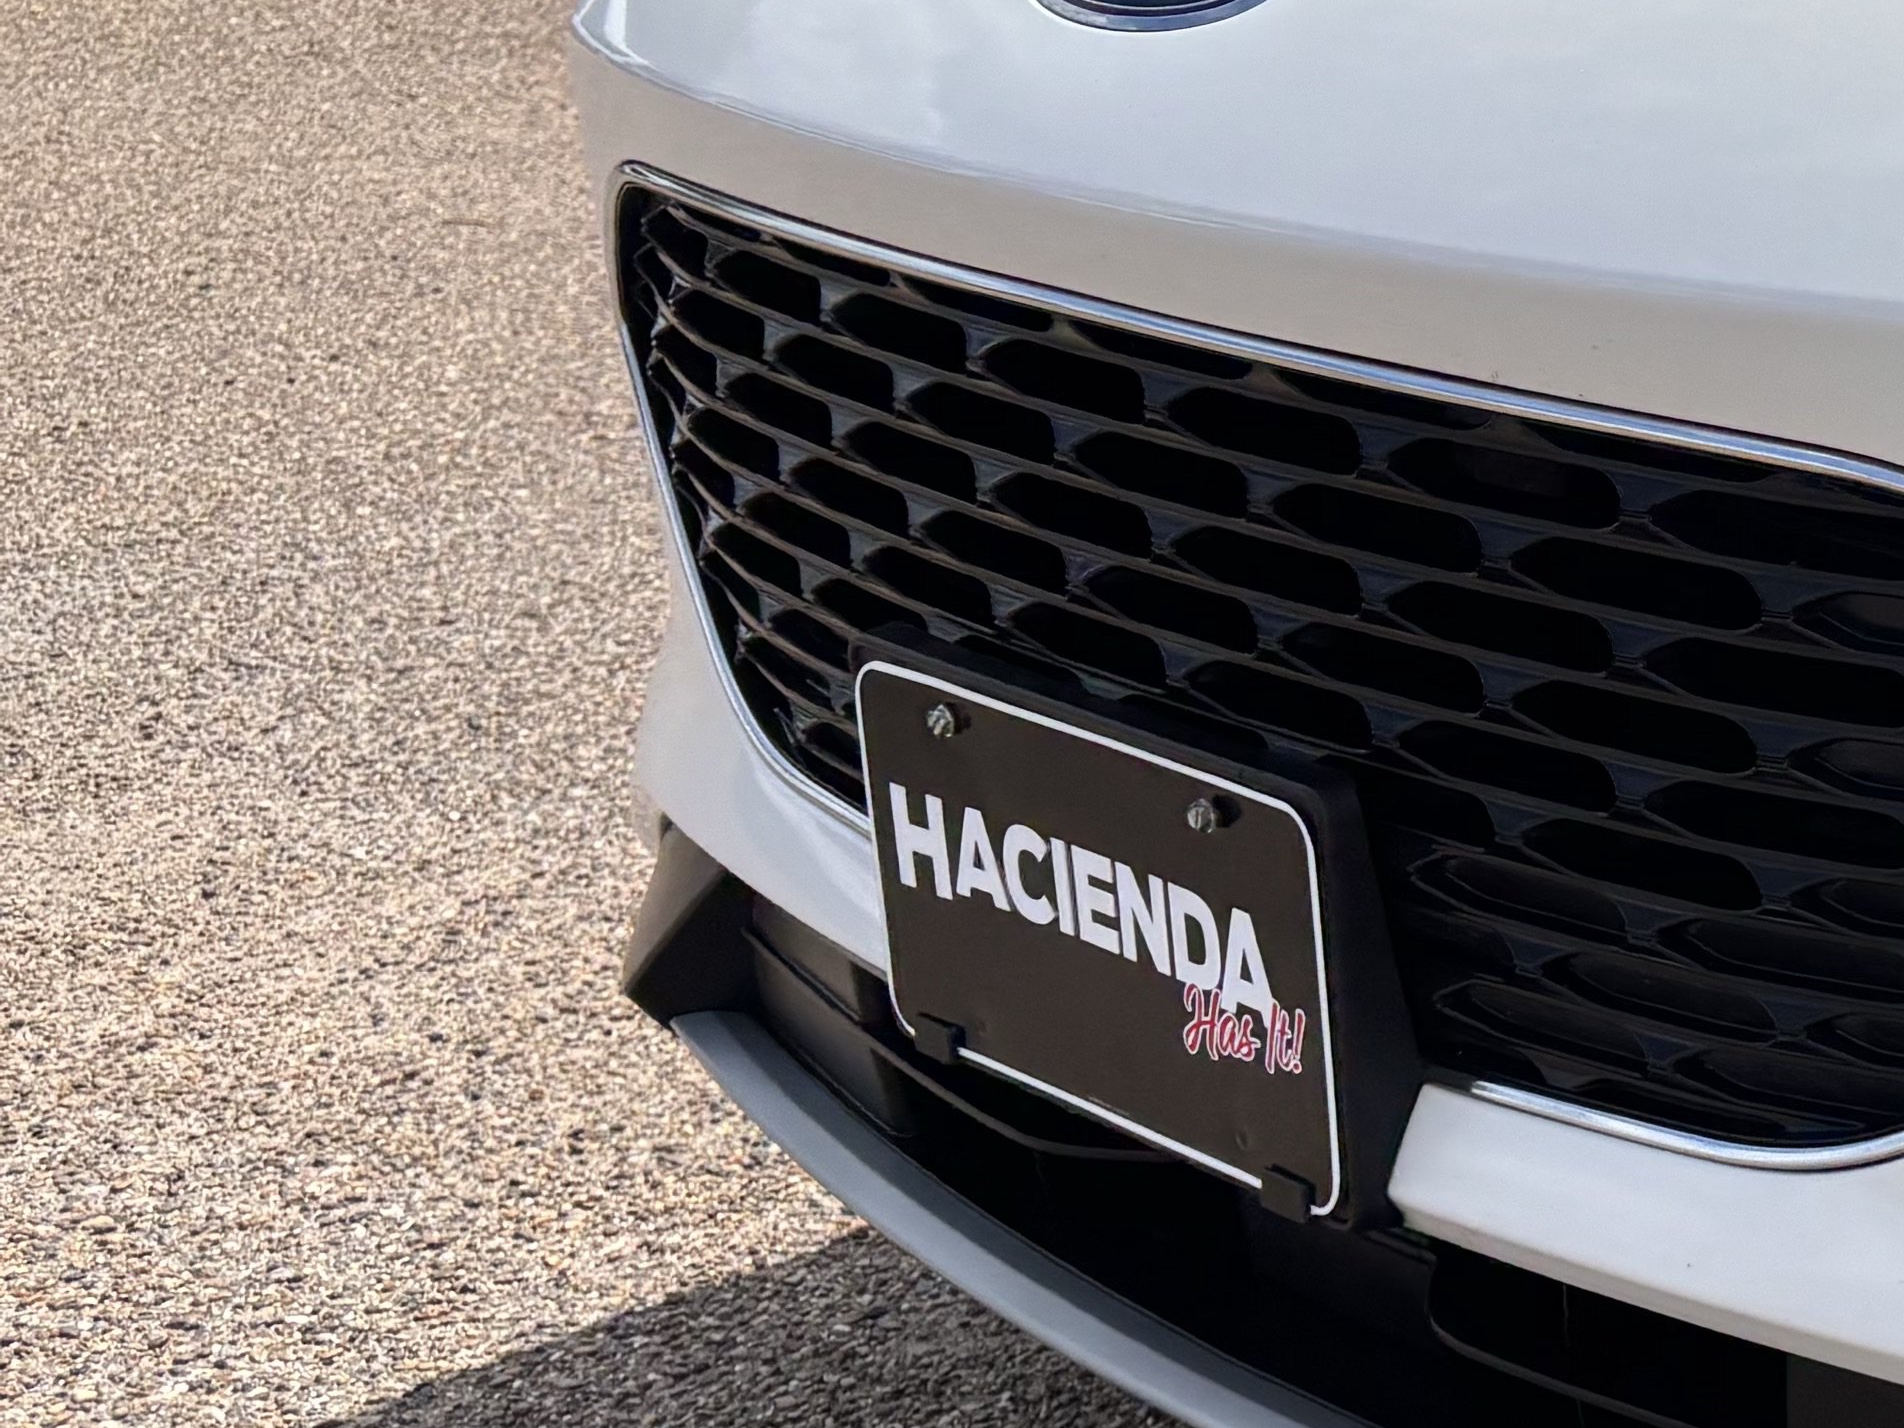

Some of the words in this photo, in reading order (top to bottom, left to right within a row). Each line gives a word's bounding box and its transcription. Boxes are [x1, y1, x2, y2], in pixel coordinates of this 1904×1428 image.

[888, 780, 1274, 1024] HACIENDA
[1182, 982, 1260, 1062] Has
[1263, 1000, 1307, 1075] It!
